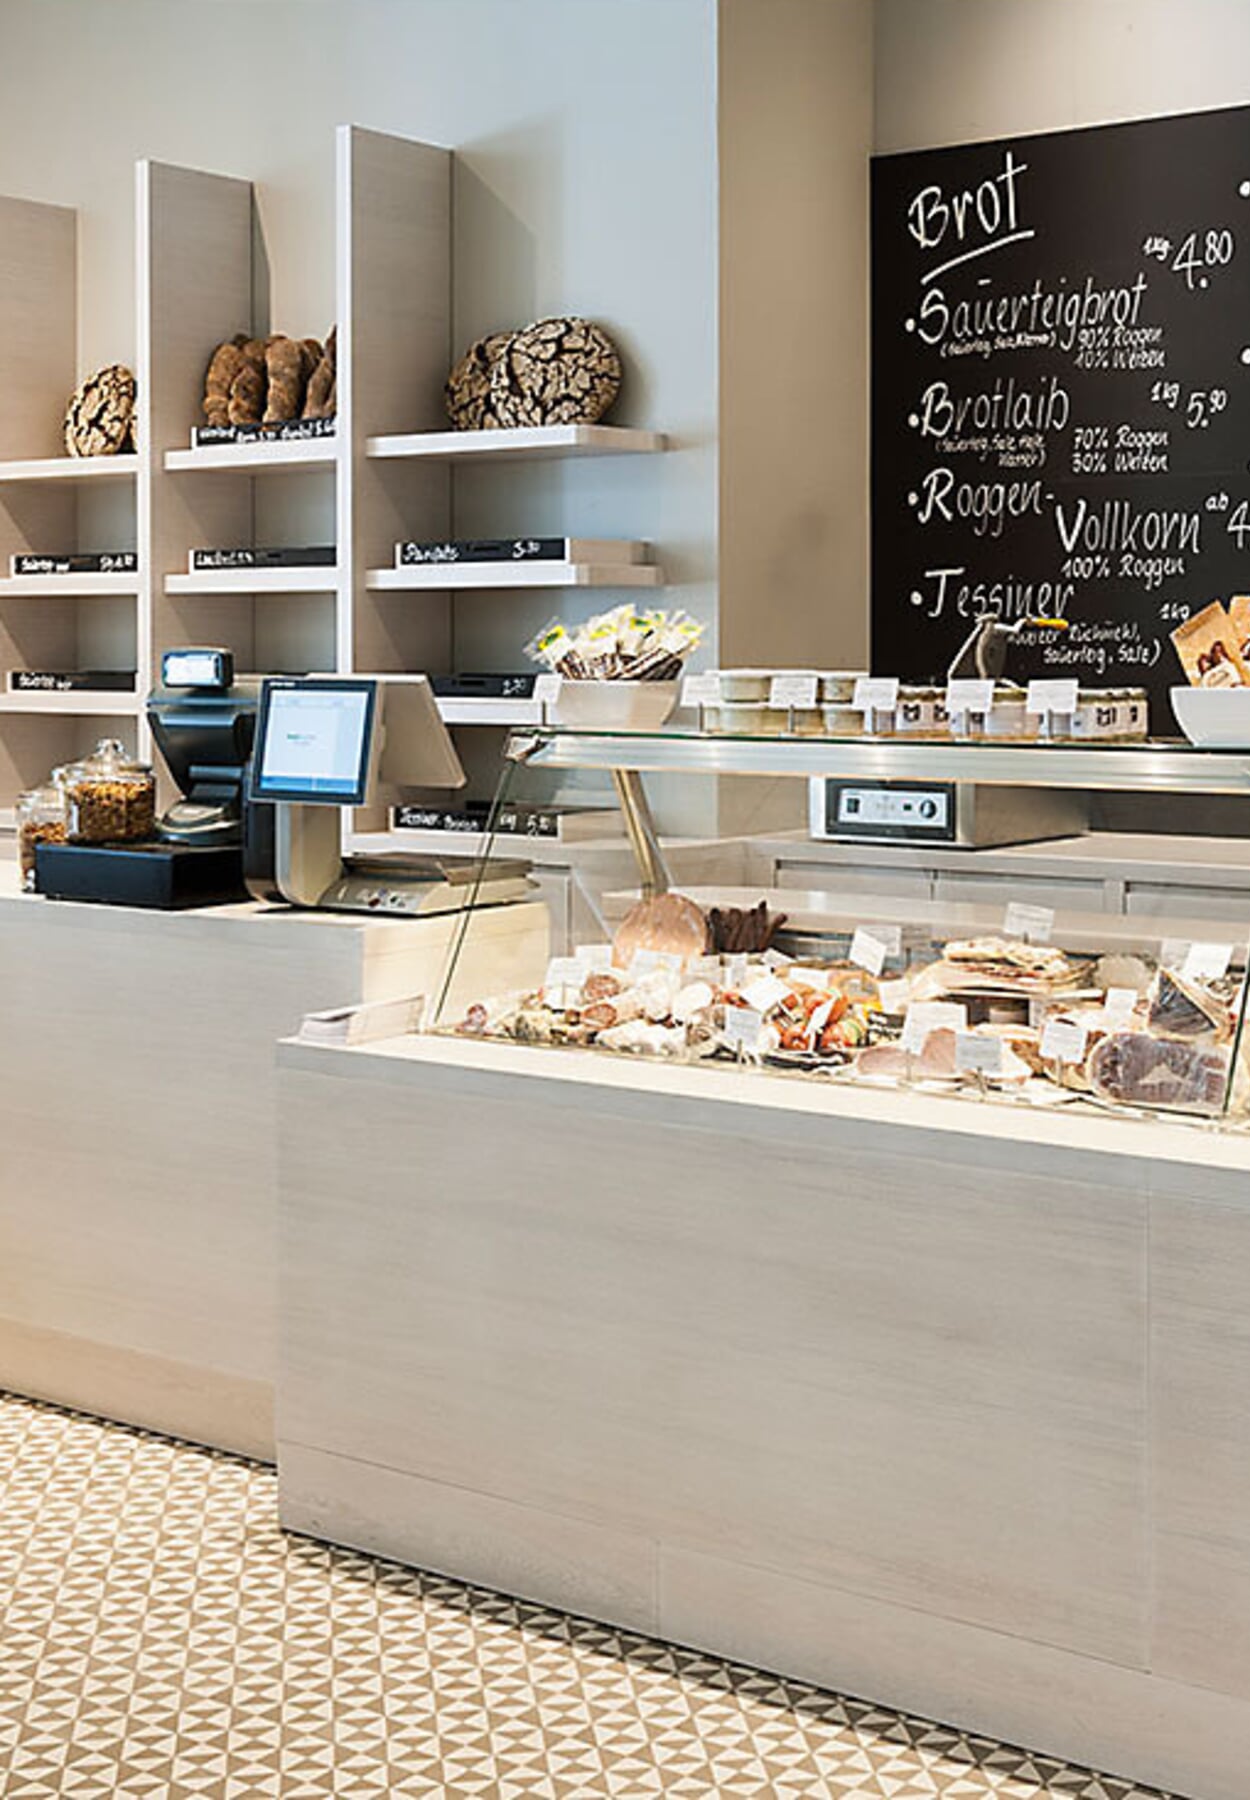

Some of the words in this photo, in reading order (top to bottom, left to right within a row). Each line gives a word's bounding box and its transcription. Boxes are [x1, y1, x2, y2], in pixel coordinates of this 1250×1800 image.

[909, 152, 1027, 247] Brot
[921, 377, 1069, 437] Brotlaib
[1114, 425, 1169, 455] Roggen
[1055, 499, 1200, 553] Vollkorn
[1205, 492, 1229, 512] ab
[924, 567, 1075, 618] Tessiner
[1061, 556, 1111, 579] 100%
[1118, 553, 1185, 591] Roggen
